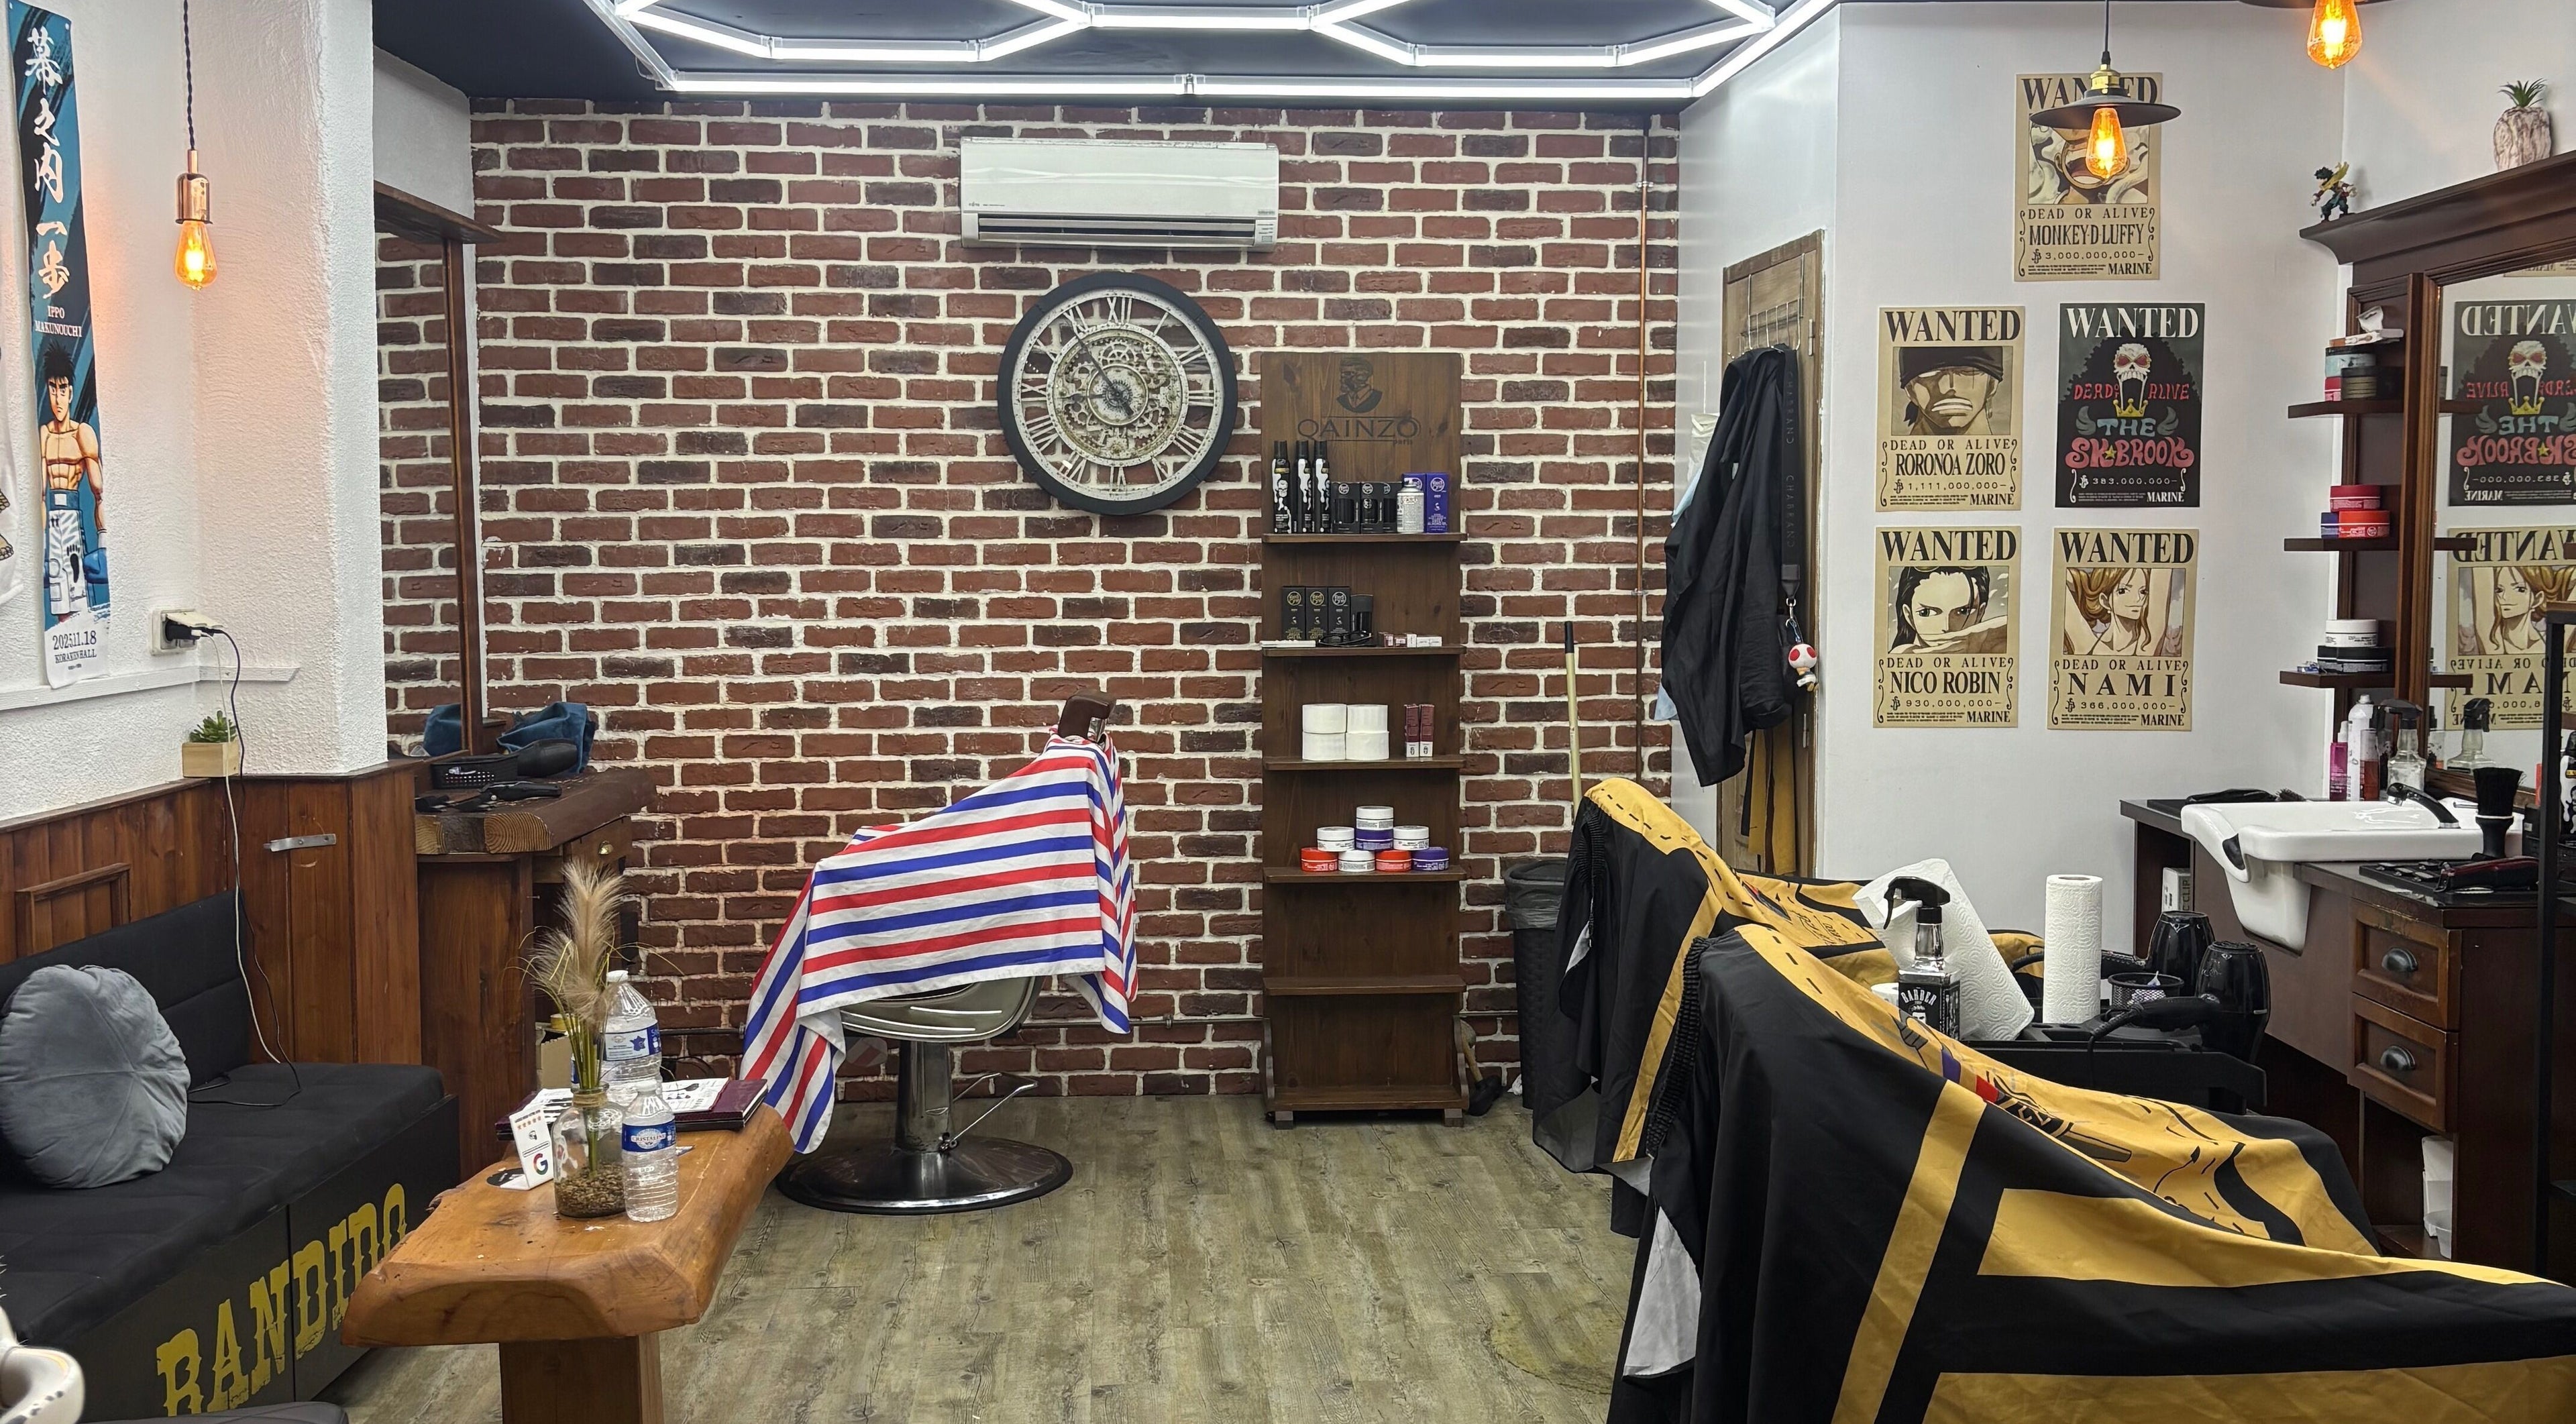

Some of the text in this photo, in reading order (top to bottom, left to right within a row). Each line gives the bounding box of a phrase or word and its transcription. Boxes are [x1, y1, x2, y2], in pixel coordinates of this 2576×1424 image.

[2028, 207, 2148, 219] DEAD OR ALIVE
[2108, 262, 2152, 275] MARINE
[48, 306, 65, 319] IPPO
[34, 320, 83, 337] MAKUNOUCHI
[1885, 309, 2021, 342] WANTED
[2067, 307, 2199, 339] WANTED
[2074, 383, 2113, 400] DEAD
[2148, 383, 2190, 400] ALIVE
[1298, 419, 1420, 441] QAINZO
[2097, 418, 2157, 437] THE
[1890, 439, 2010, 450] DEAD OR ALIVE
[1895, 452, 2005, 476] RORONOA ZORO
[1970, 493, 2015, 506] MARINE
[2146, 492, 2185, 502] MARINE
[1881, 531, 2017, 561] WANTED
[2059, 532, 2194, 563] WANTED
[1887, 657, 2007, 668] DEAD OR ALIVE
[2063, 659, 2182, 671] DEAD OR ALIVE
[1890, 671, 2000, 694] NICO ROBIN
[2068, 673, 2176, 697] NAMI
[1966, 711, 2011, 723] MARINE
[2141, 714, 2184, 726] MARINE
[2182, 880, 2190, 902] CLIP
[1900, 989, 1937, 1005] BARBER
